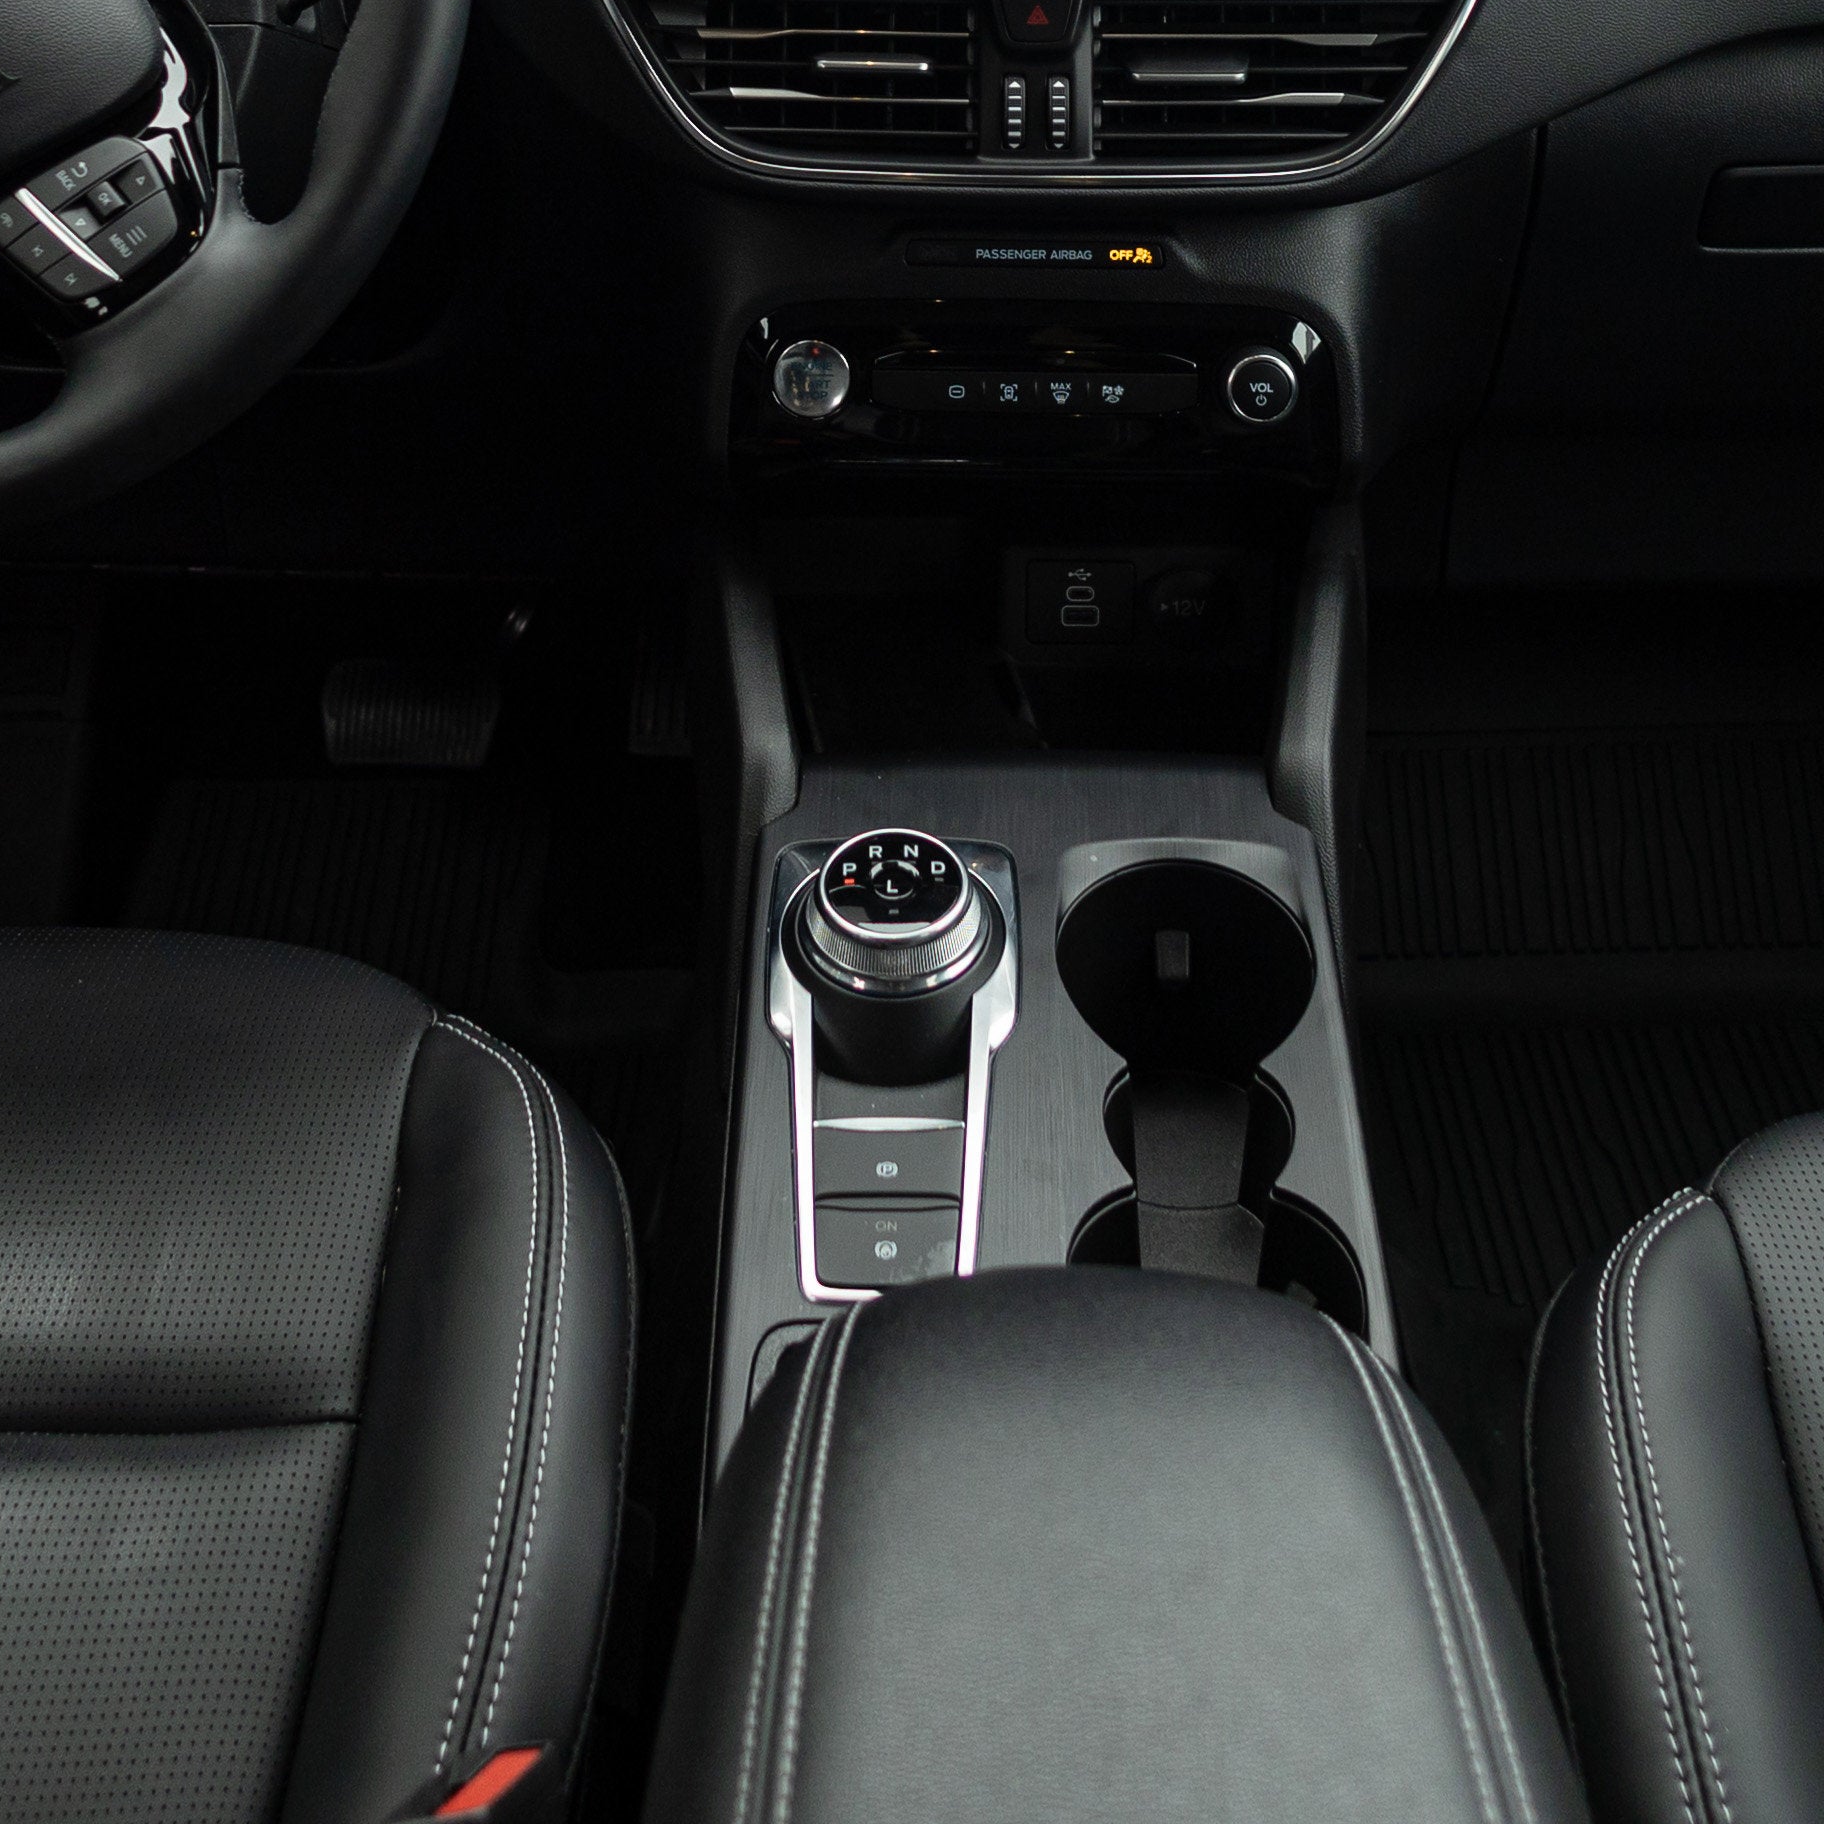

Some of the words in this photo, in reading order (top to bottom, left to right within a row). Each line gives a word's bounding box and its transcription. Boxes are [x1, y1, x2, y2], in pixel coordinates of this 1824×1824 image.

[56, 169, 76, 191] BACK
[108, 232, 133, 259] MENU
[976, 248, 1047, 260] PASSENGER
[1050, 249, 1093, 261] AIRBAG
[1109, 249, 1133, 261] OFF
[1050, 382, 1072, 391] MAX
[1249, 382, 1274, 394] VOL
[868, 845, 883, 859] R
[903, 844, 919, 858] N
[842, 862, 857, 876] P
[930, 861, 946, 875] D
[886, 879, 898, 894] L
[875, 1220, 897, 1232] ON
